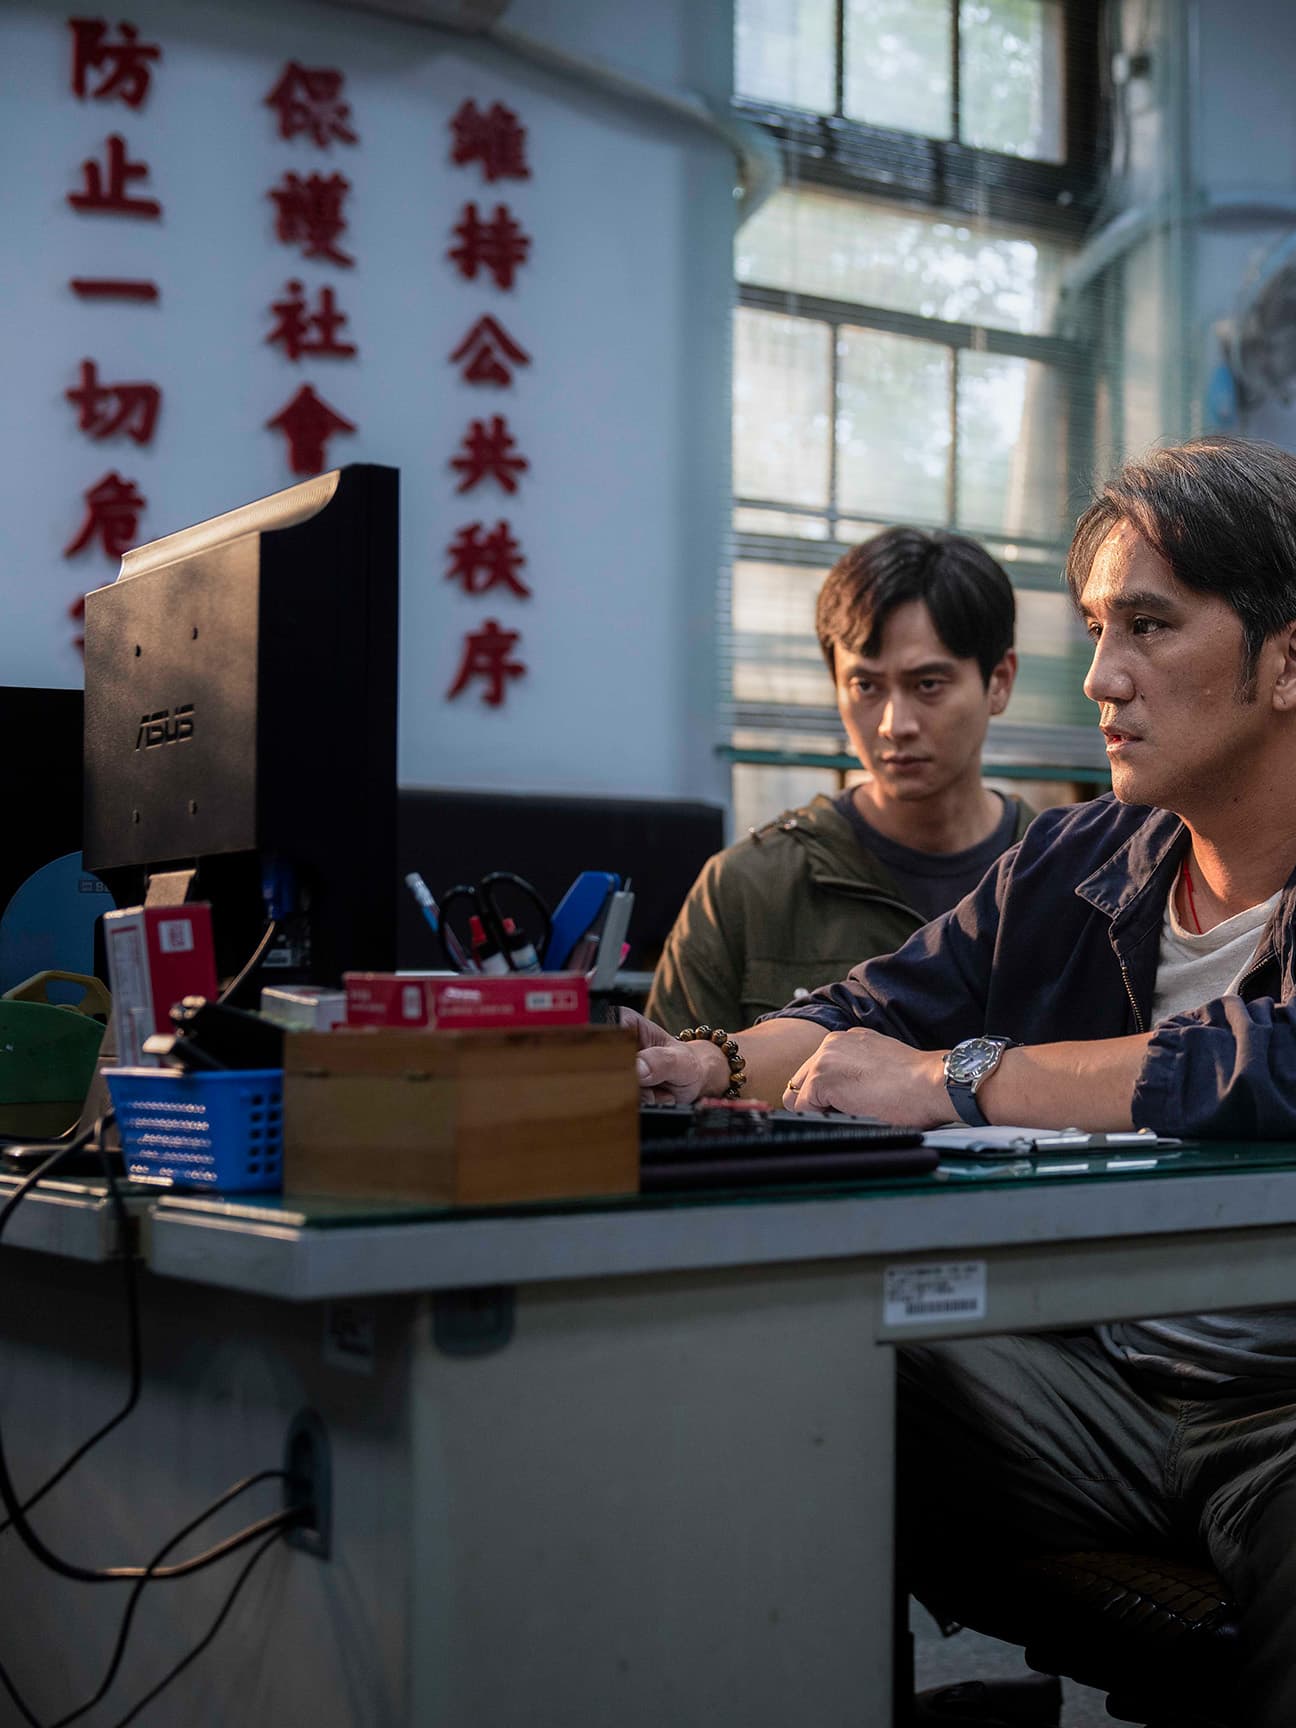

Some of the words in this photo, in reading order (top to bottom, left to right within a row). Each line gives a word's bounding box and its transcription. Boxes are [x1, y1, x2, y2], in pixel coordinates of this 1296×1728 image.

[65, 18, 161, 660] 防止一切危
[447, 97, 532, 708] 維持公共秩序
[135, 703, 195, 751] ASUS
